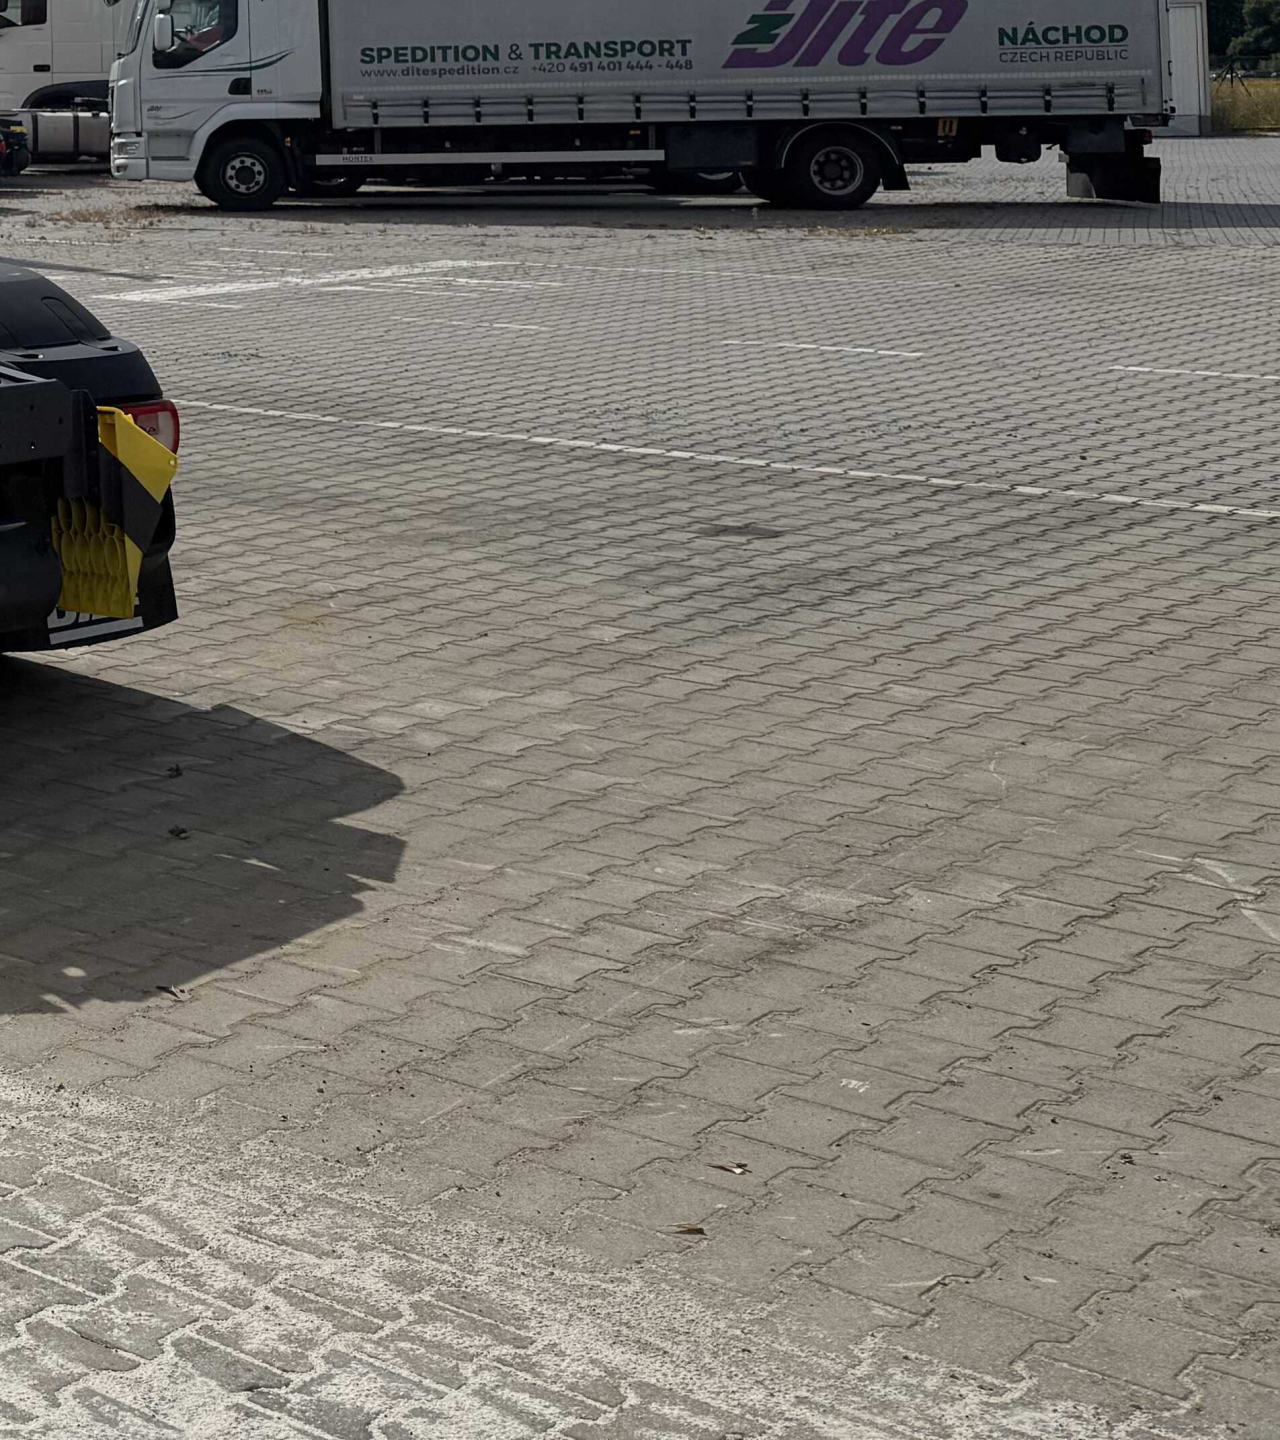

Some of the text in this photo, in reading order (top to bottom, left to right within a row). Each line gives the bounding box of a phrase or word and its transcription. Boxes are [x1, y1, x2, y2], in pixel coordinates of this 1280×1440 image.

[998, 21, 1129, 46] NÁCHOD
[360, 39, 692, 65] SPEDITION & TRANSPORT
[999, 49, 1129, 63] CZECH REPUBLIC
[360, 64, 519, 78] www.ditespedition.cz
[531, 61, 566, 73] +420
[569, 61, 594, 72] 491
[597, 60, 623, 72] 401
[626, 60, 653, 71] 444
[666, 59, 694, 70] 448
